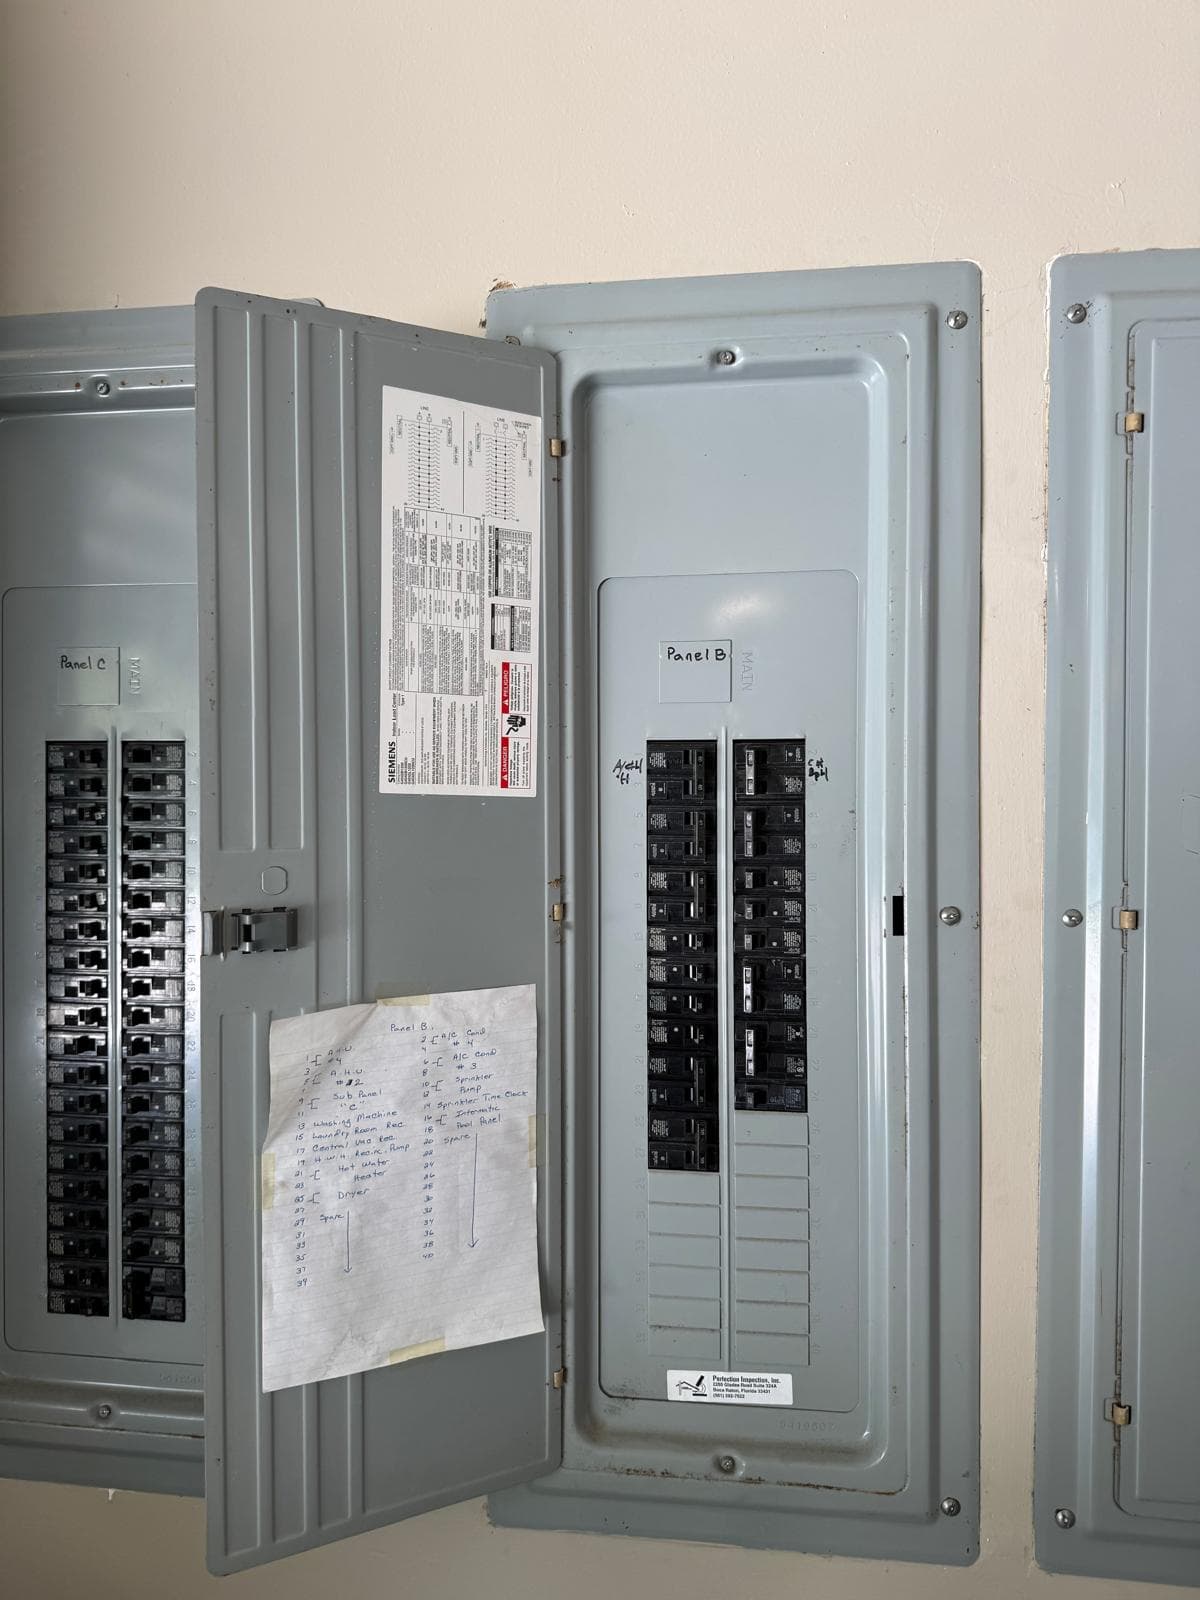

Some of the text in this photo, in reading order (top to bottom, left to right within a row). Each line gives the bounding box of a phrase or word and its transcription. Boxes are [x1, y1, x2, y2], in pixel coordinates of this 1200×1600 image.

[667, 646, 726, 662] Panel B
[60, 655, 106, 670] Panel C
[129, 657, 141, 695] MAIN
[741, 652, 754, 691] MAIN
[388, 741, 396, 783] SIEMENS
[390, 1023, 415, 1032] Panel
[441, 1032, 457, 1040] A/C
[466, 1027, 486, 1036] Cond
[467, 1039, 473, 1047] 4
[453, 1053, 469, 1061] A/C
[475, 1048, 497, 1057] Cond
[455, 1073, 494, 1084] Sprinkler
[333, 1091, 353, 1100] Sub
[358, 1089, 382, 1099] Panel
[460, 1085, 481, 1094] Pump
[437, 1098, 479, 1110] Sprinkler
[480, 1115, 501, 1126] Panel
[354, 1126, 377, 1135] Room
[312, 1142, 349, 1152] Central
[389, 1143, 410, 1152] Pump
[338, 1188, 370, 1200] Dryer
[294, 1219, 305, 1227] 29
[296, 1231, 305, 1239] 31
[296, 1254, 307, 1262] 35
[296, 1266, 306, 1274] 37
